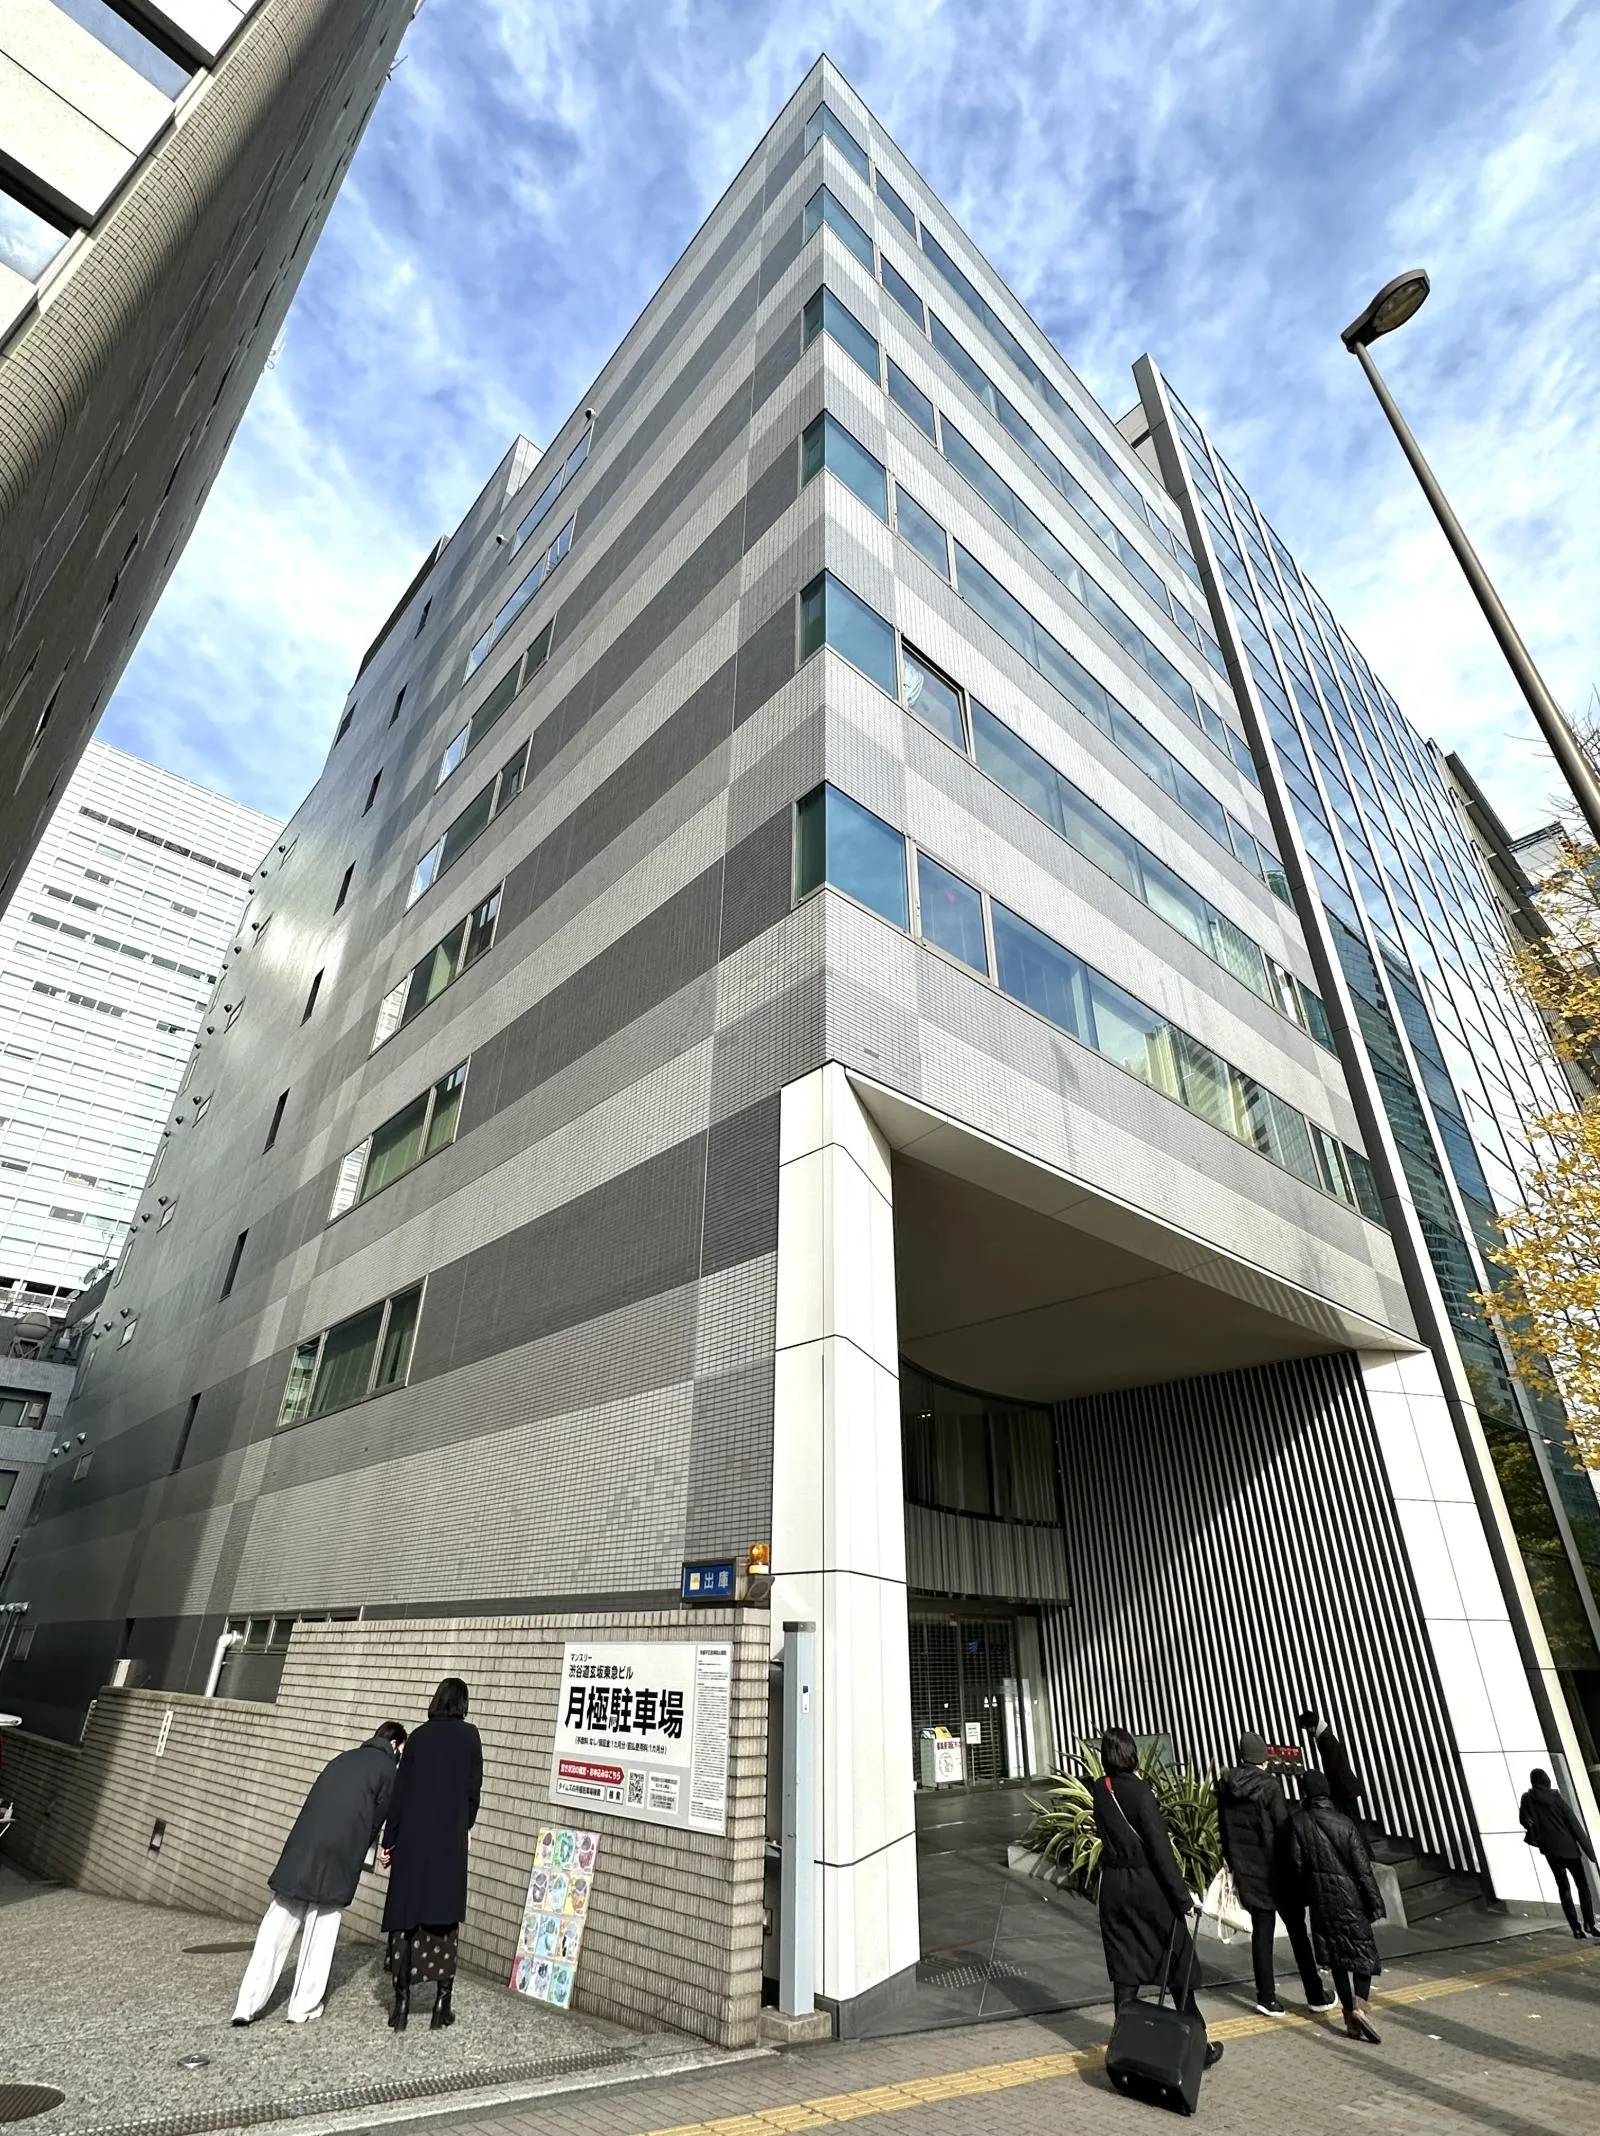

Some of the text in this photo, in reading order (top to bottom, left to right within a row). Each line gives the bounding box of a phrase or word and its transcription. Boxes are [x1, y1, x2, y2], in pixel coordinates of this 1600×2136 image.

[704, 1570, 729, 1589] 出庫
[570, 1653, 593, 1662] マンスリー
[568, 1664, 634, 1680] 渋谷道玄坂東急ビル
[565, 1685, 684, 1739] 月極駐車場
